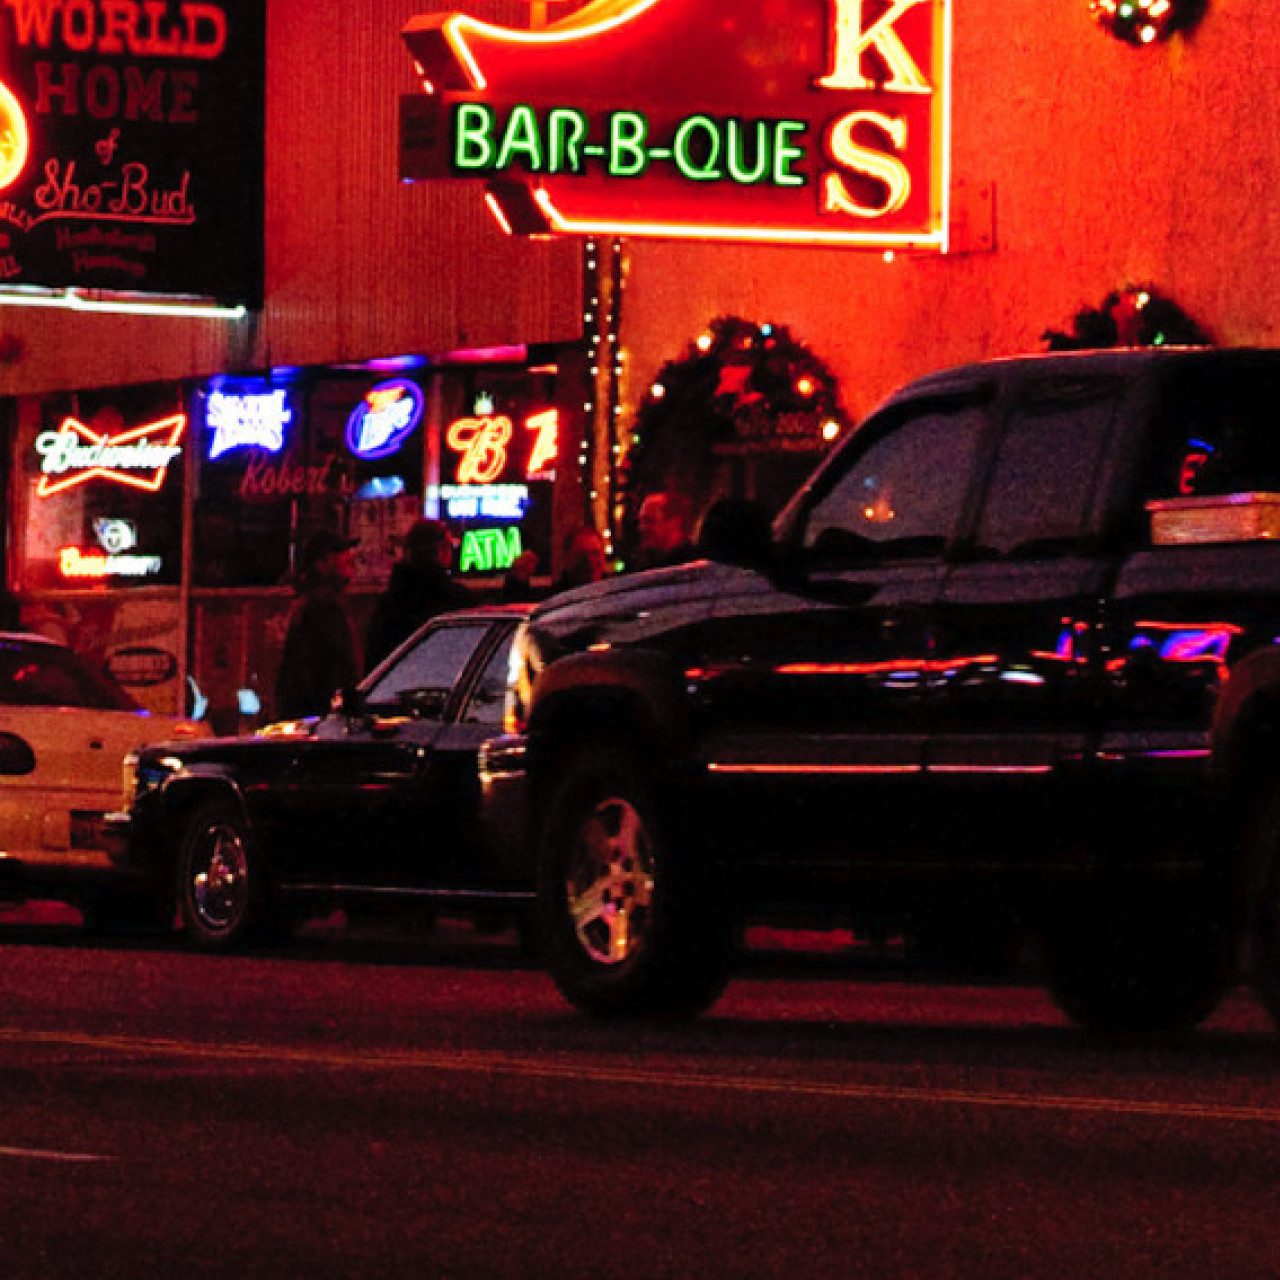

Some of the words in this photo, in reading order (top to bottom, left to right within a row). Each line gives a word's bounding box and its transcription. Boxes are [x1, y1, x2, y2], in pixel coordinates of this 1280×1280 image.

[34, 60, 198, 123] HOME
[94, 127, 121, 166] of
[455, 103, 808, 186] BAR-B-QUE
[34, 156, 194, 216] Sho-Bud
[460, 525, 522, 574] ATM
